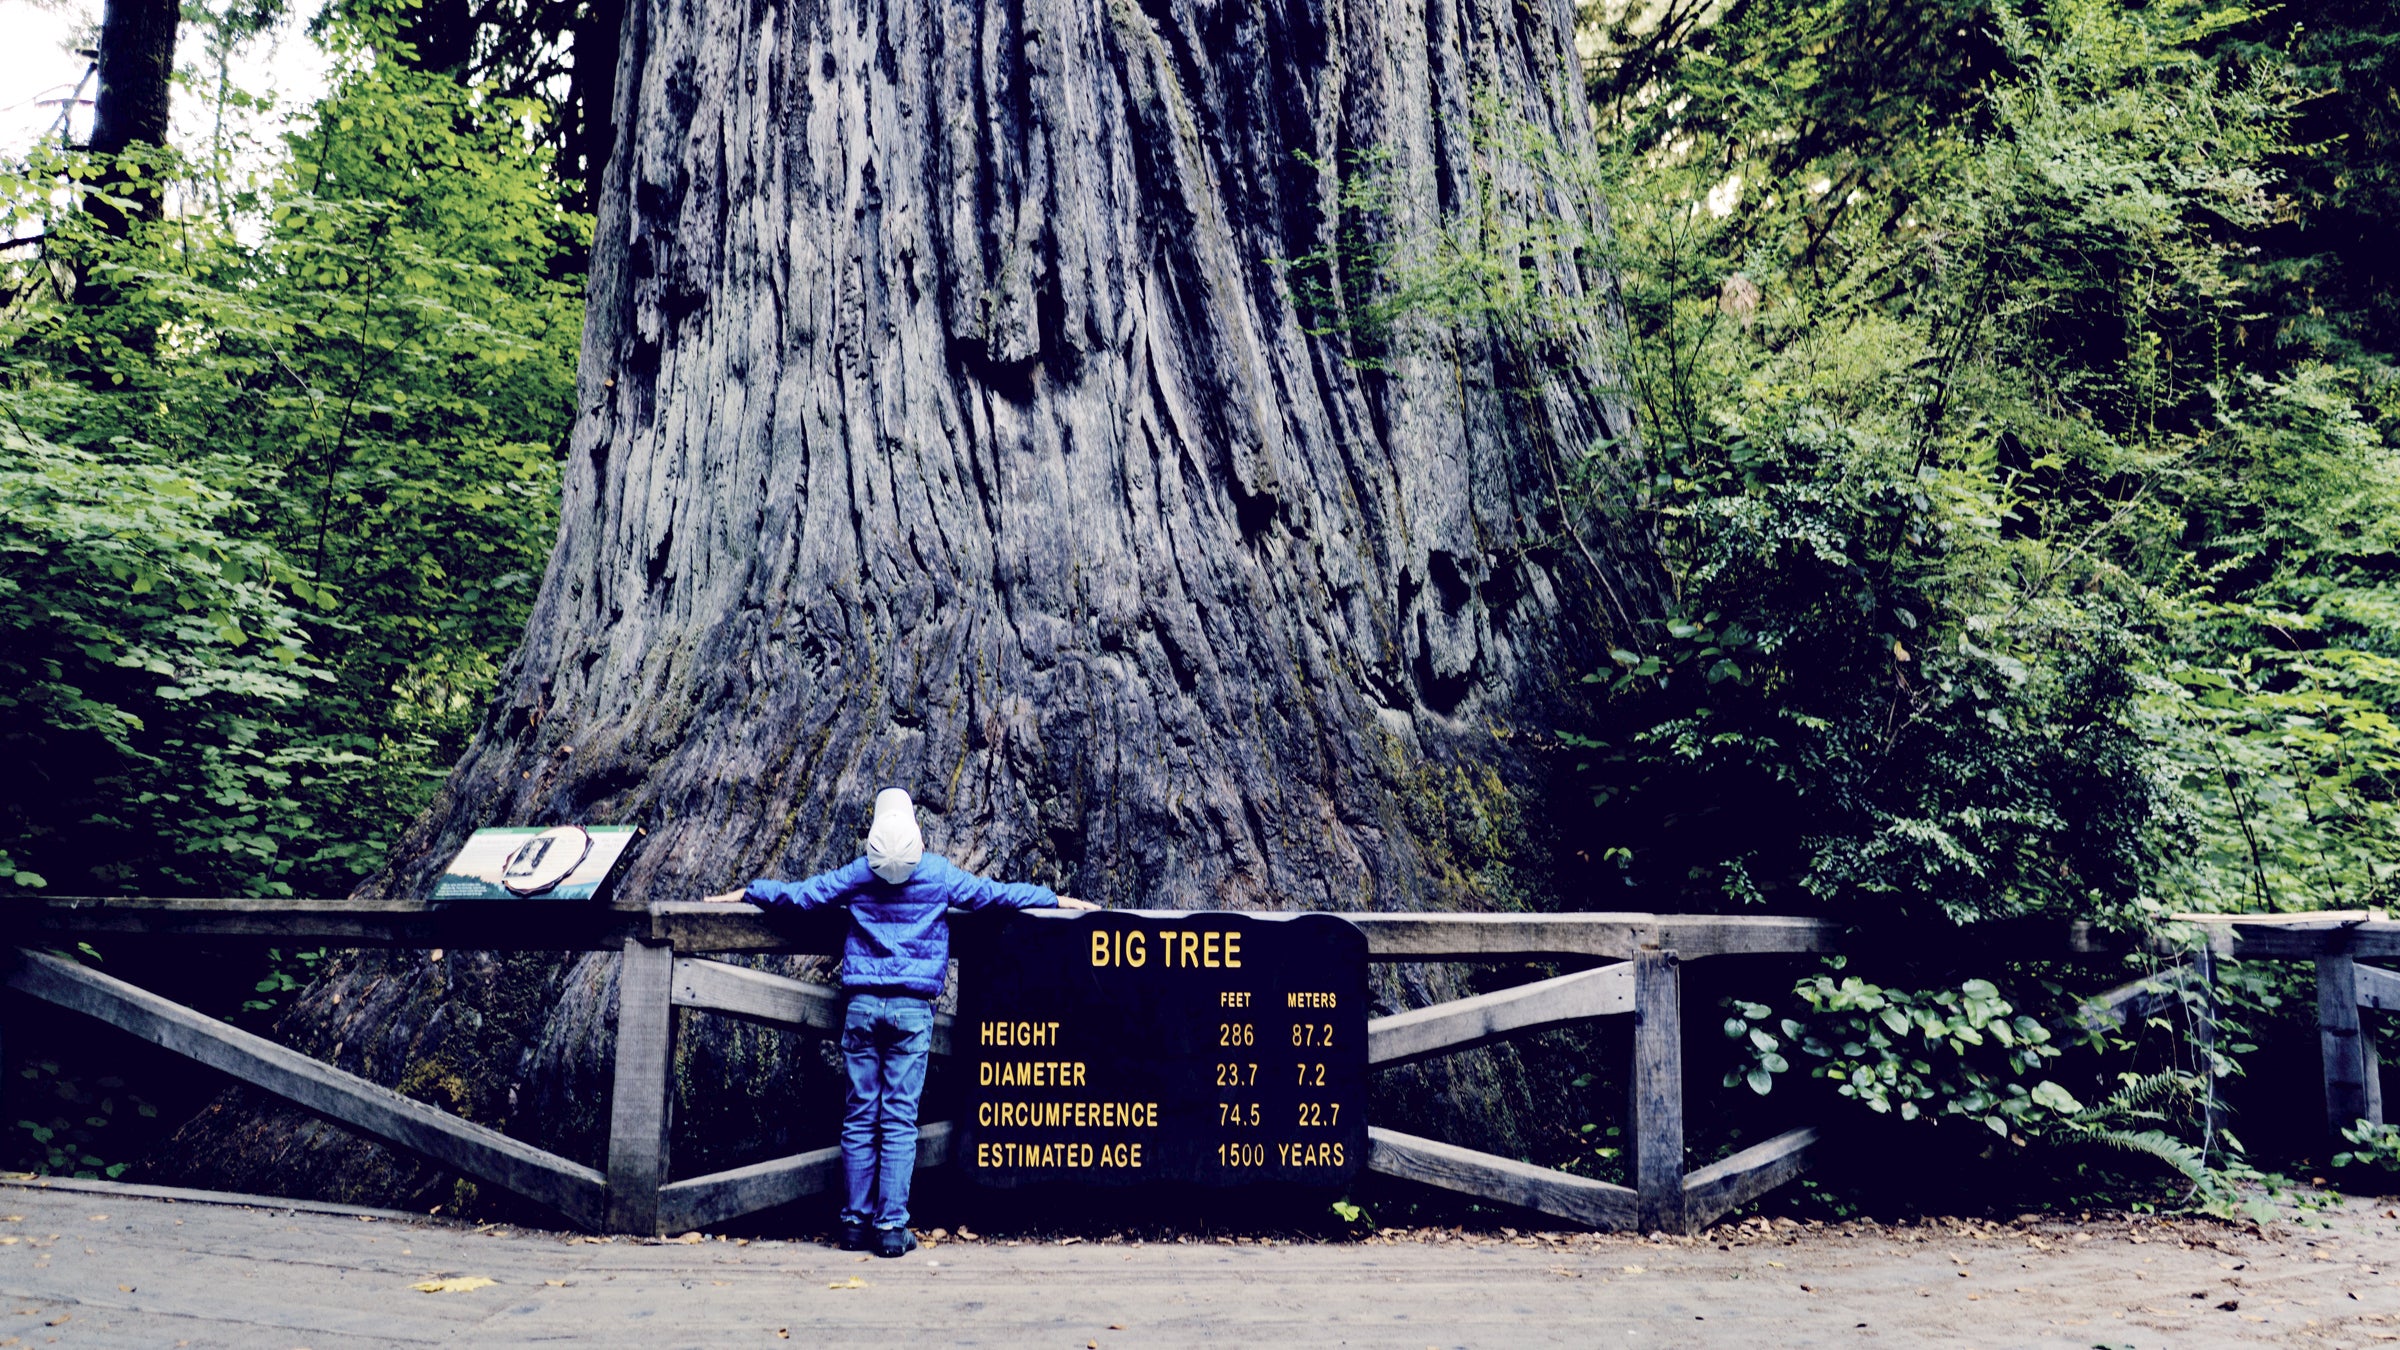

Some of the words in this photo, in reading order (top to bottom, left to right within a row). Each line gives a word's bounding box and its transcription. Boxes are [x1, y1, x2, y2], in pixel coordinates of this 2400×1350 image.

[1091, 930, 1146, 968] BIG
[1159, 930, 1242, 969] TREE
[1220, 991, 1252, 1008] FEET
[1287, 992, 1337, 1009] METERS
[981, 1021, 1060, 1047] HEIGHT
[1220, 1023, 1254, 1047] 286
[1292, 1023, 1333, 1047] 87.2
[980, 1061, 1086, 1087] DIAMETER
[1216, 1063, 1258, 1087] 23.7
[1297, 1063, 1326, 1087] 7.2
[978, 1101, 1158, 1128] CIRCUMFERENCE
[1219, 1103, 1260, 1127] 74.5
[1298, 1102, 1340, 1127] 22.7
[977, 1142, 1094, 1168] ESTIMATED
[1100, 1142, 1142, 1168] AGE
[1217, 1142, 1264, 1167] 1500
[1278, 1142, 1345, 1167] YEARS
